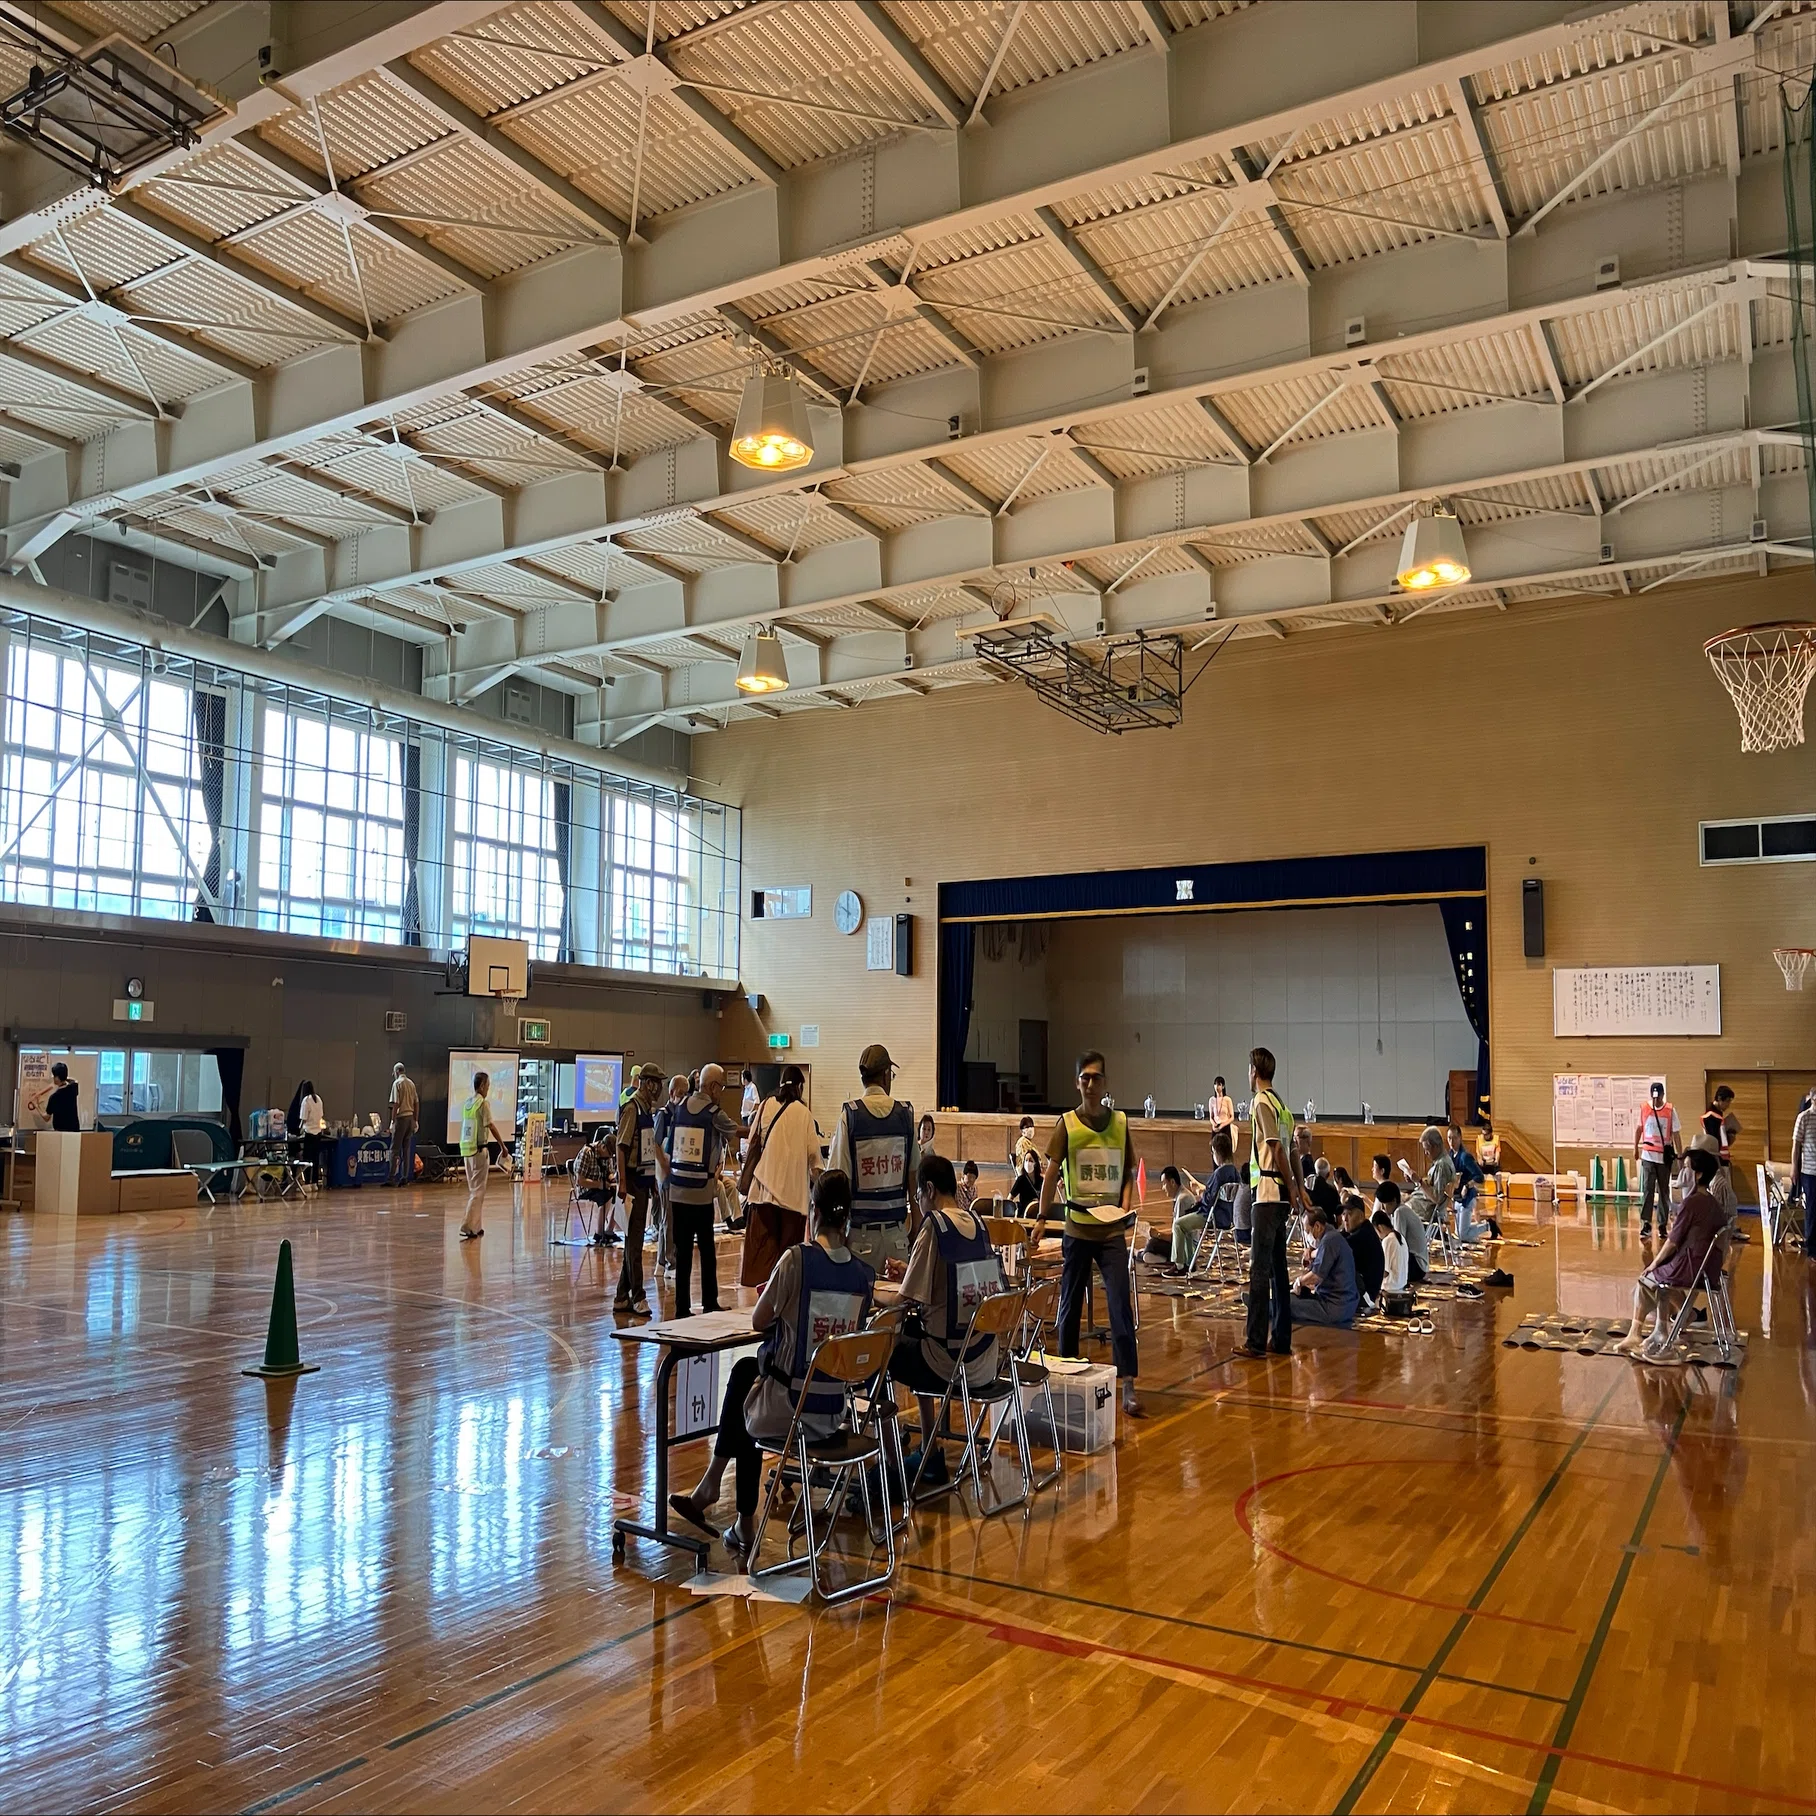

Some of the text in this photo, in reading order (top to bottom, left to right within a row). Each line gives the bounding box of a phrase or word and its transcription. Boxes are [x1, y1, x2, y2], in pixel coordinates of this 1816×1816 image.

[861, 1154, 903, 1176] 受付係
[1080, 1164, 1120, 1182] 誘導係
